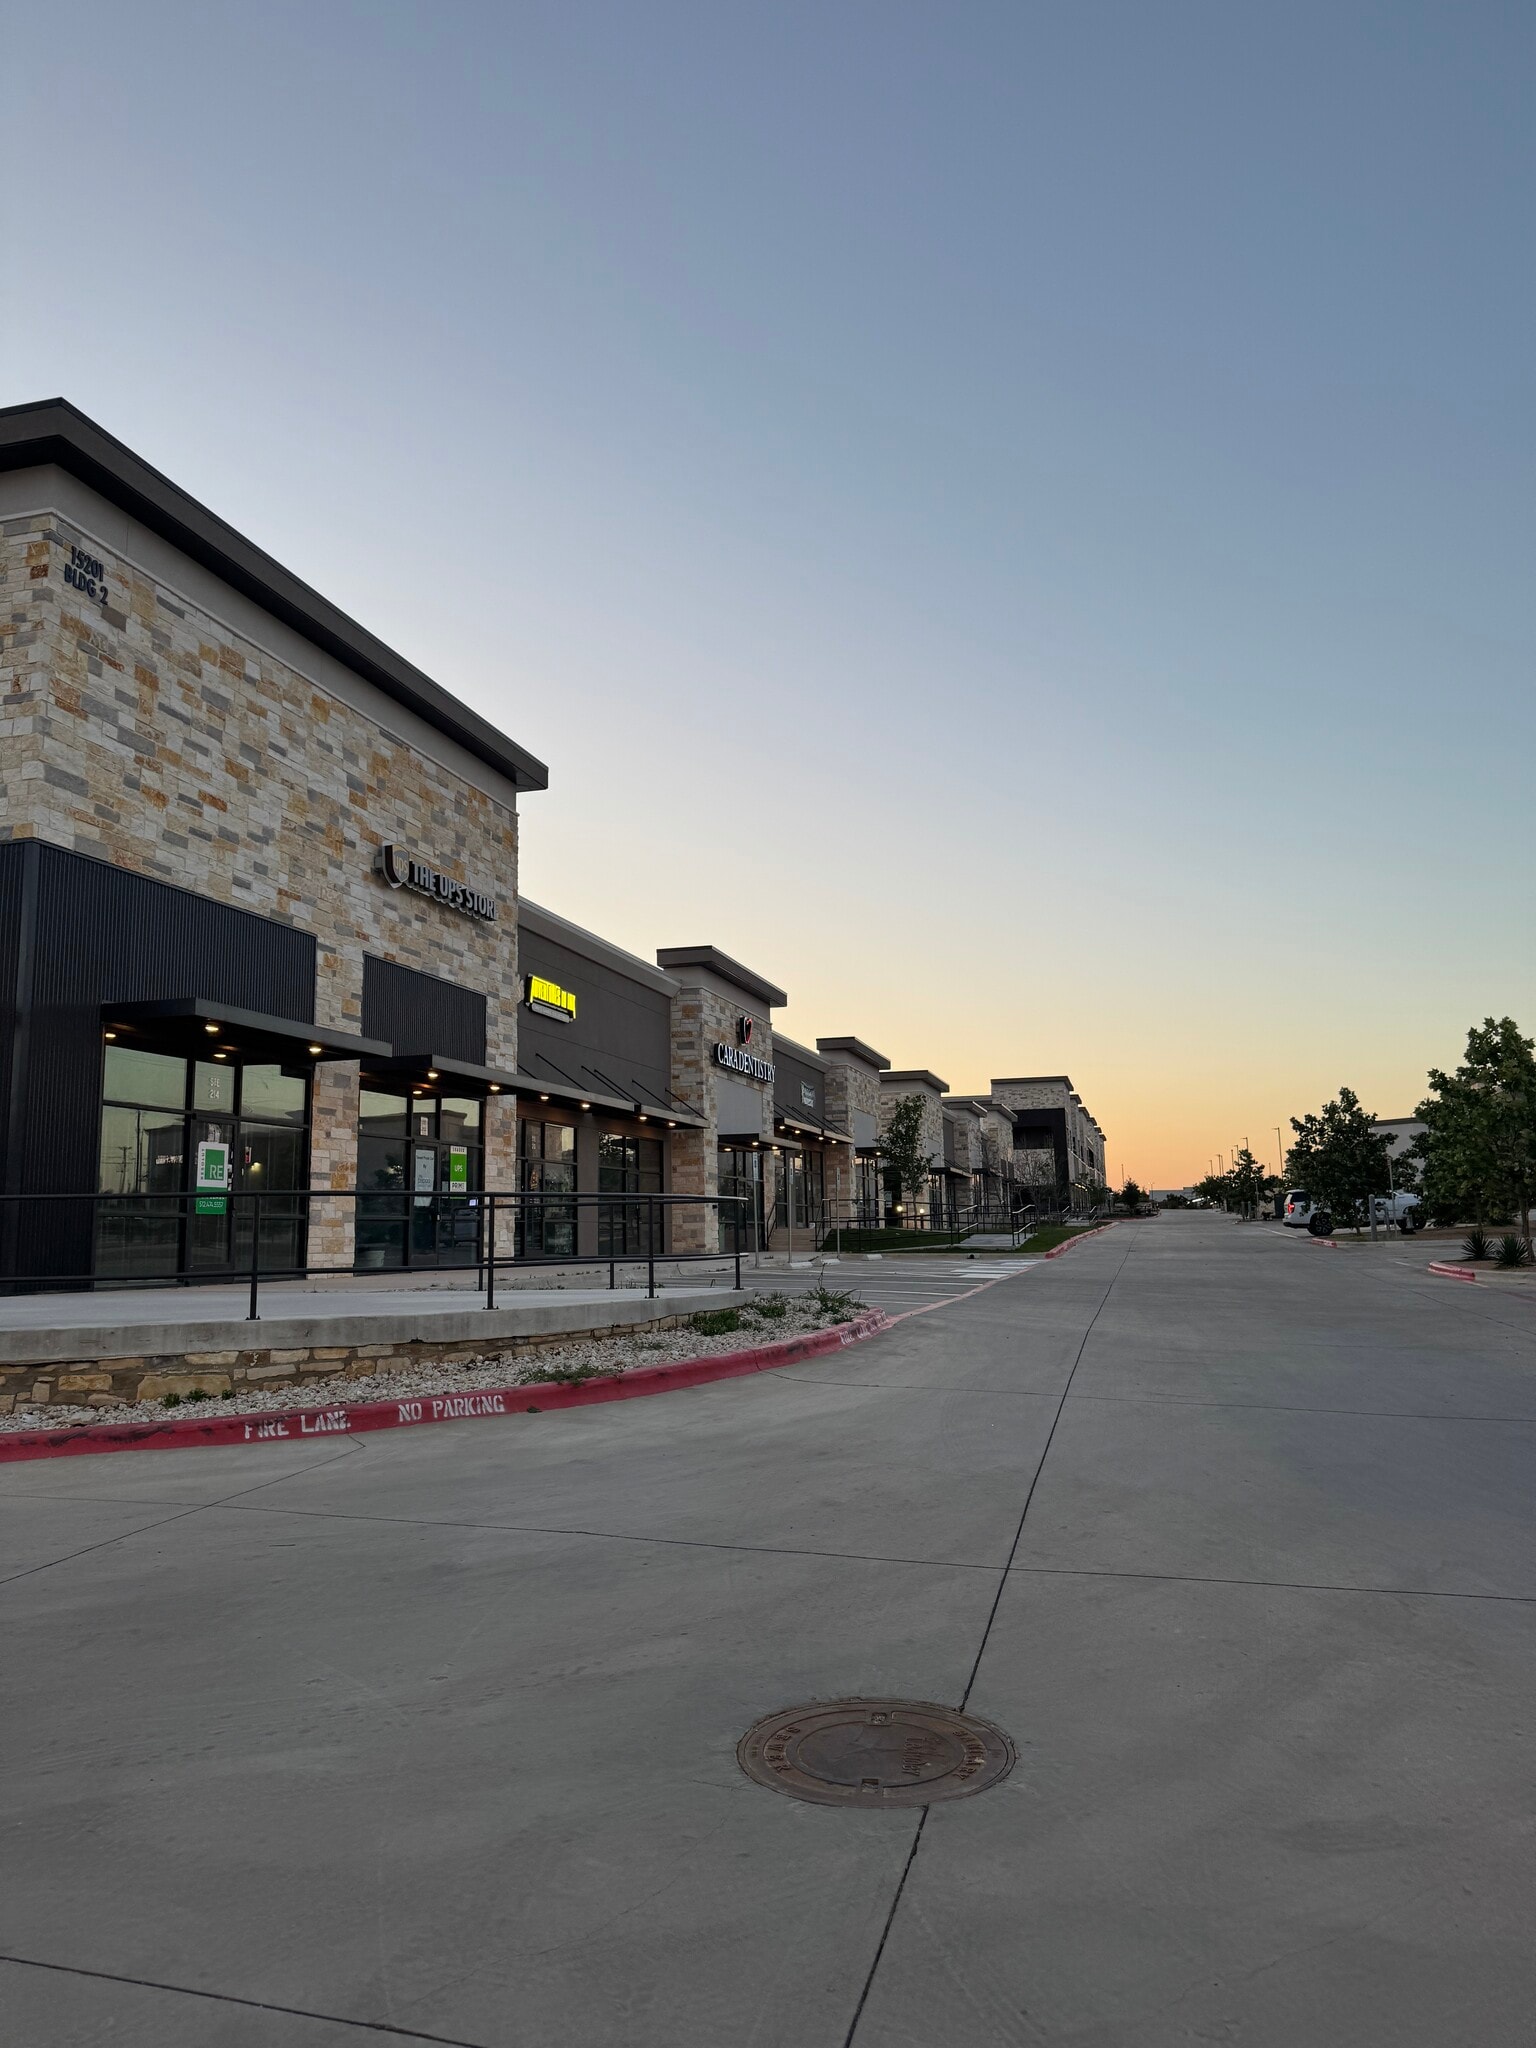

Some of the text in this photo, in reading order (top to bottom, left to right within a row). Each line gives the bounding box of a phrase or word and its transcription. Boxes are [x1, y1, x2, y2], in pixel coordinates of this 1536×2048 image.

[71, 545, 104, 582] 15201
[64, 563, 109, 606] BLDG 2
[411, 861, 437, 893] THE
[439, 875, 464, 904] UPS
[209, 1077, 221, 1087] STE
[717, 1042, 776, 1083] CARA DENTISTRY
[209, 1089, 220, 1099] 214
[209, 1164, 224, 1180] RE
[244, 1394, 505, 1440] FIRE LANE NO PARKING
